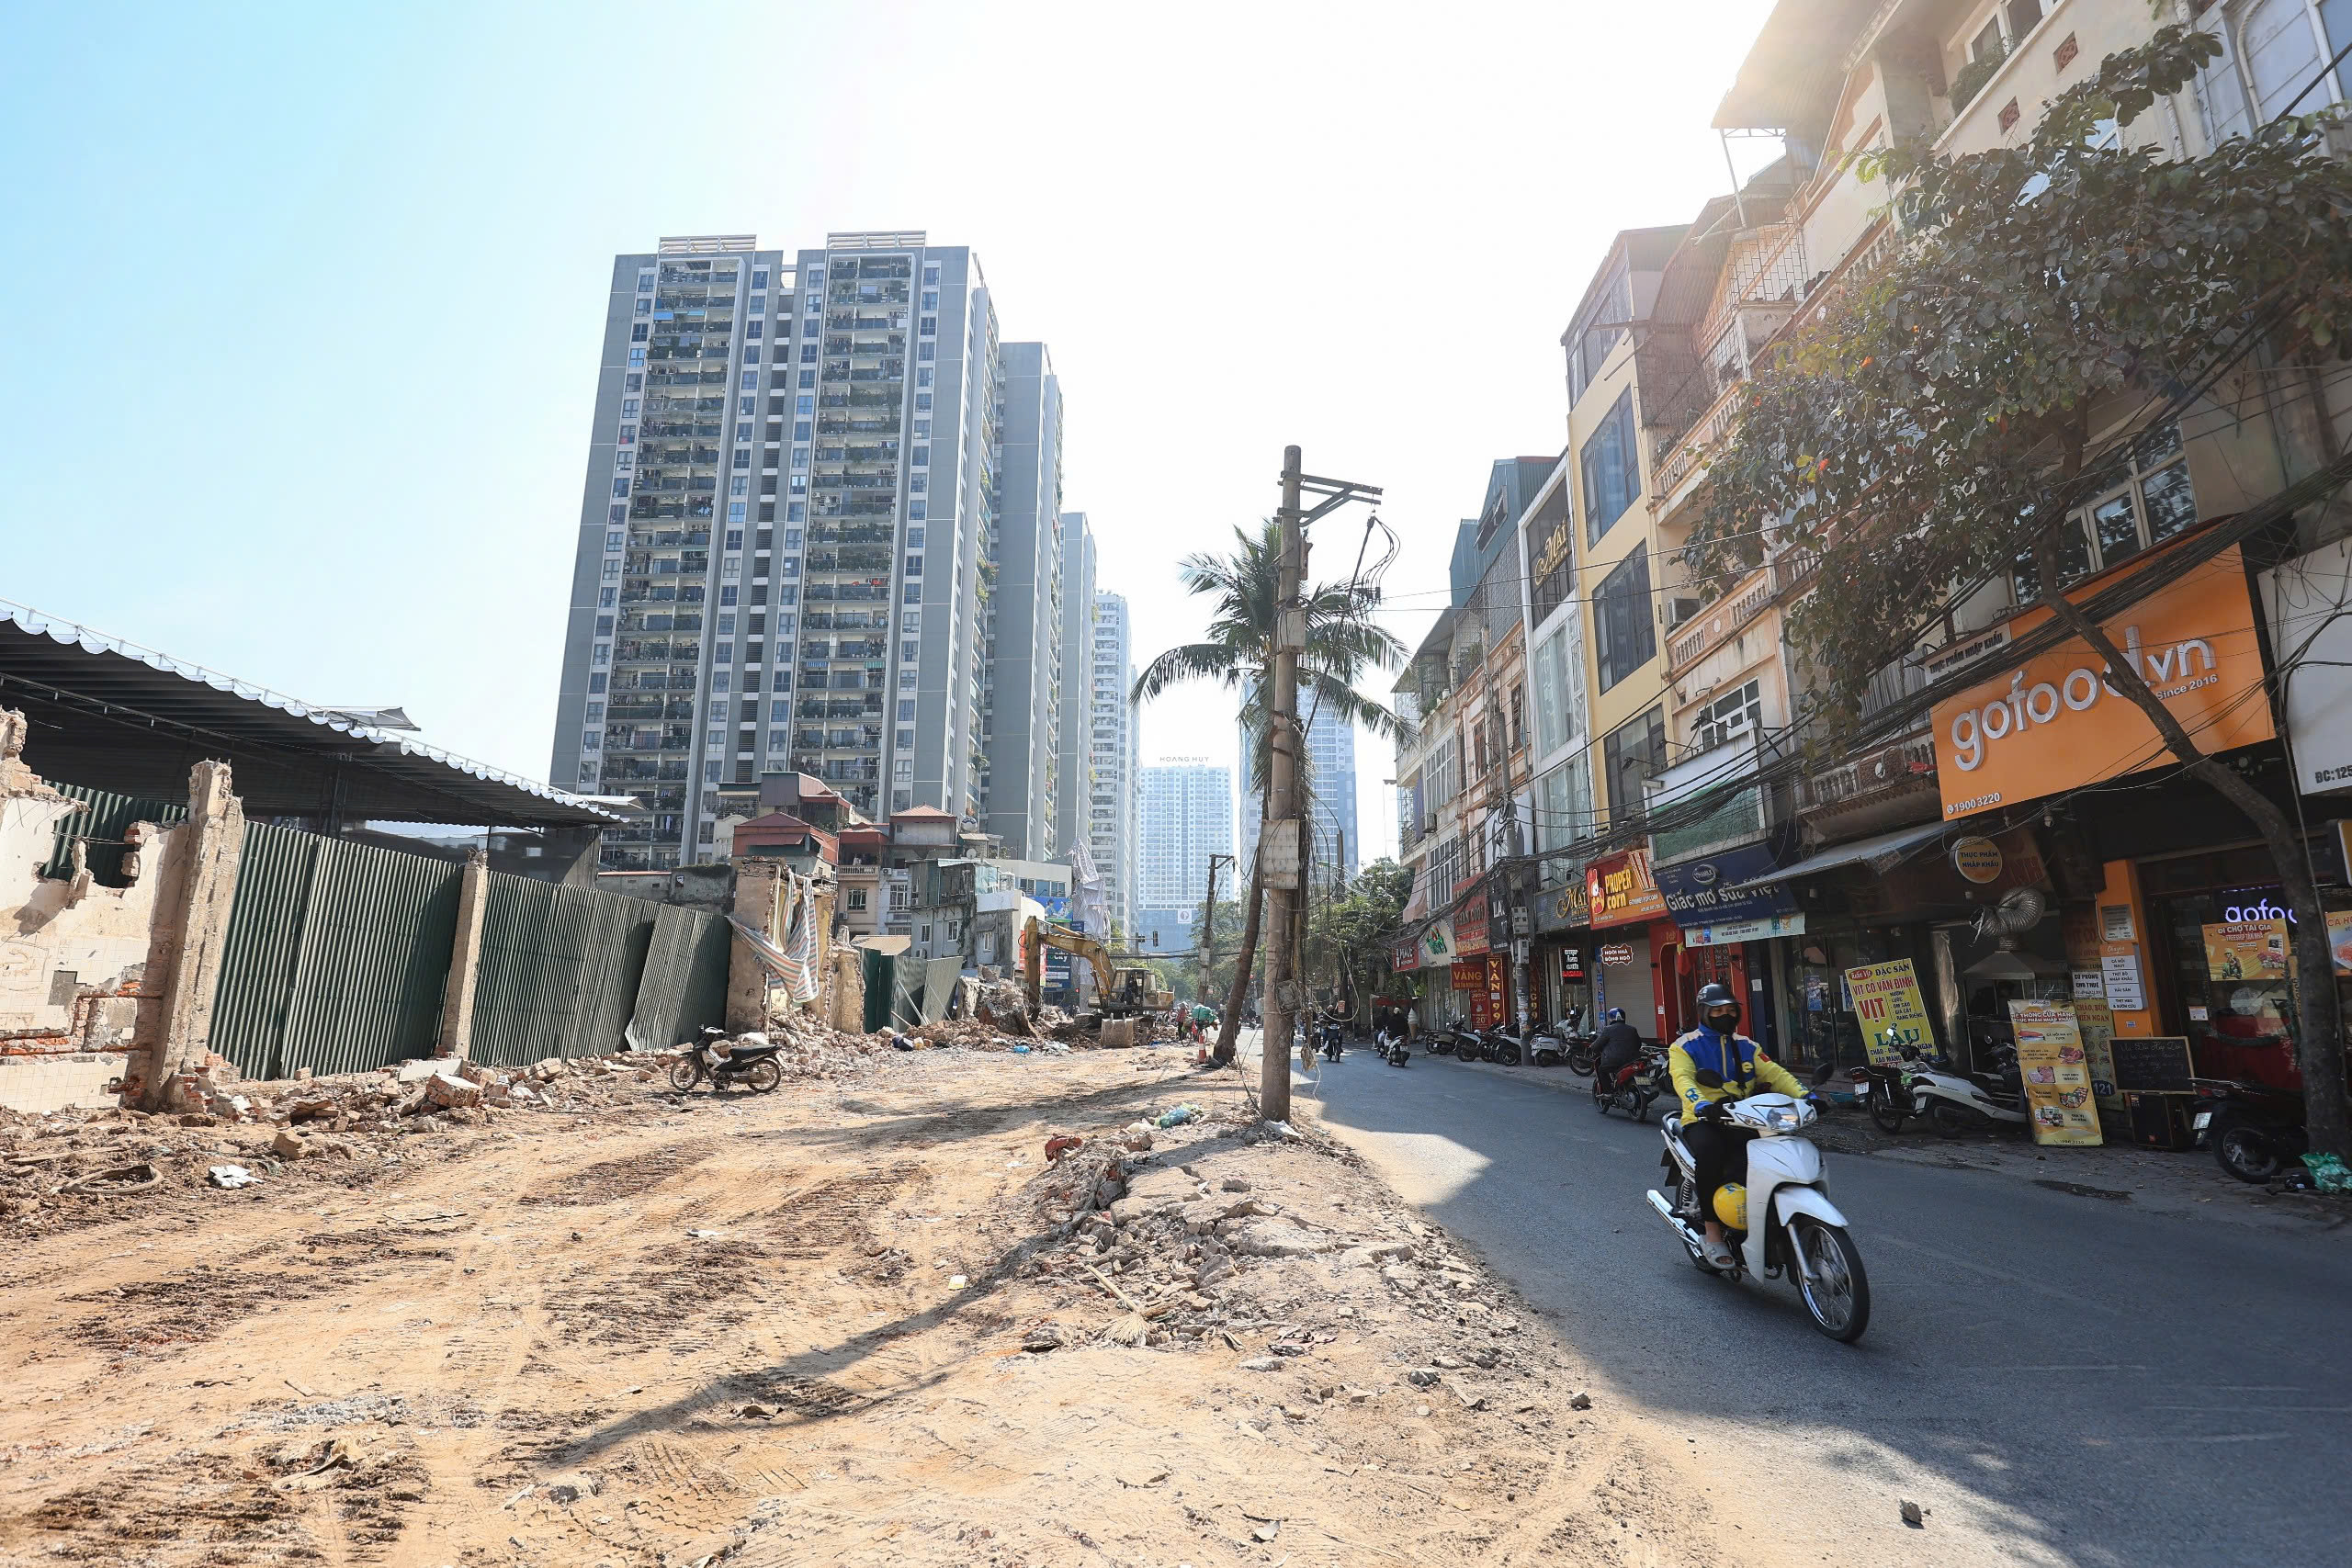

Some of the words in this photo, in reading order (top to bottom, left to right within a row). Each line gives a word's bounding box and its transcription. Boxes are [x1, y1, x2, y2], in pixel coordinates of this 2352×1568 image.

[2156, 685, 2188, 700] Since
[2189, 674, 2218, 691] 2016
[1954, 799, 1976, 813] 1900
[1976, 793, 2001, 807] 3220
[1605, 869, 1633, 895] PROPER
[1666, 888, 1695, 911] Giấc
[1695, 888, 1716, 906] mơ
[1453, 969, 1483, 981] VÀNG
[1859, 998, 1885, 1022] VỊT
[1874, 1022, 1919, 1047] LẨU
[2094, 1081, 2112, 1094] 121
